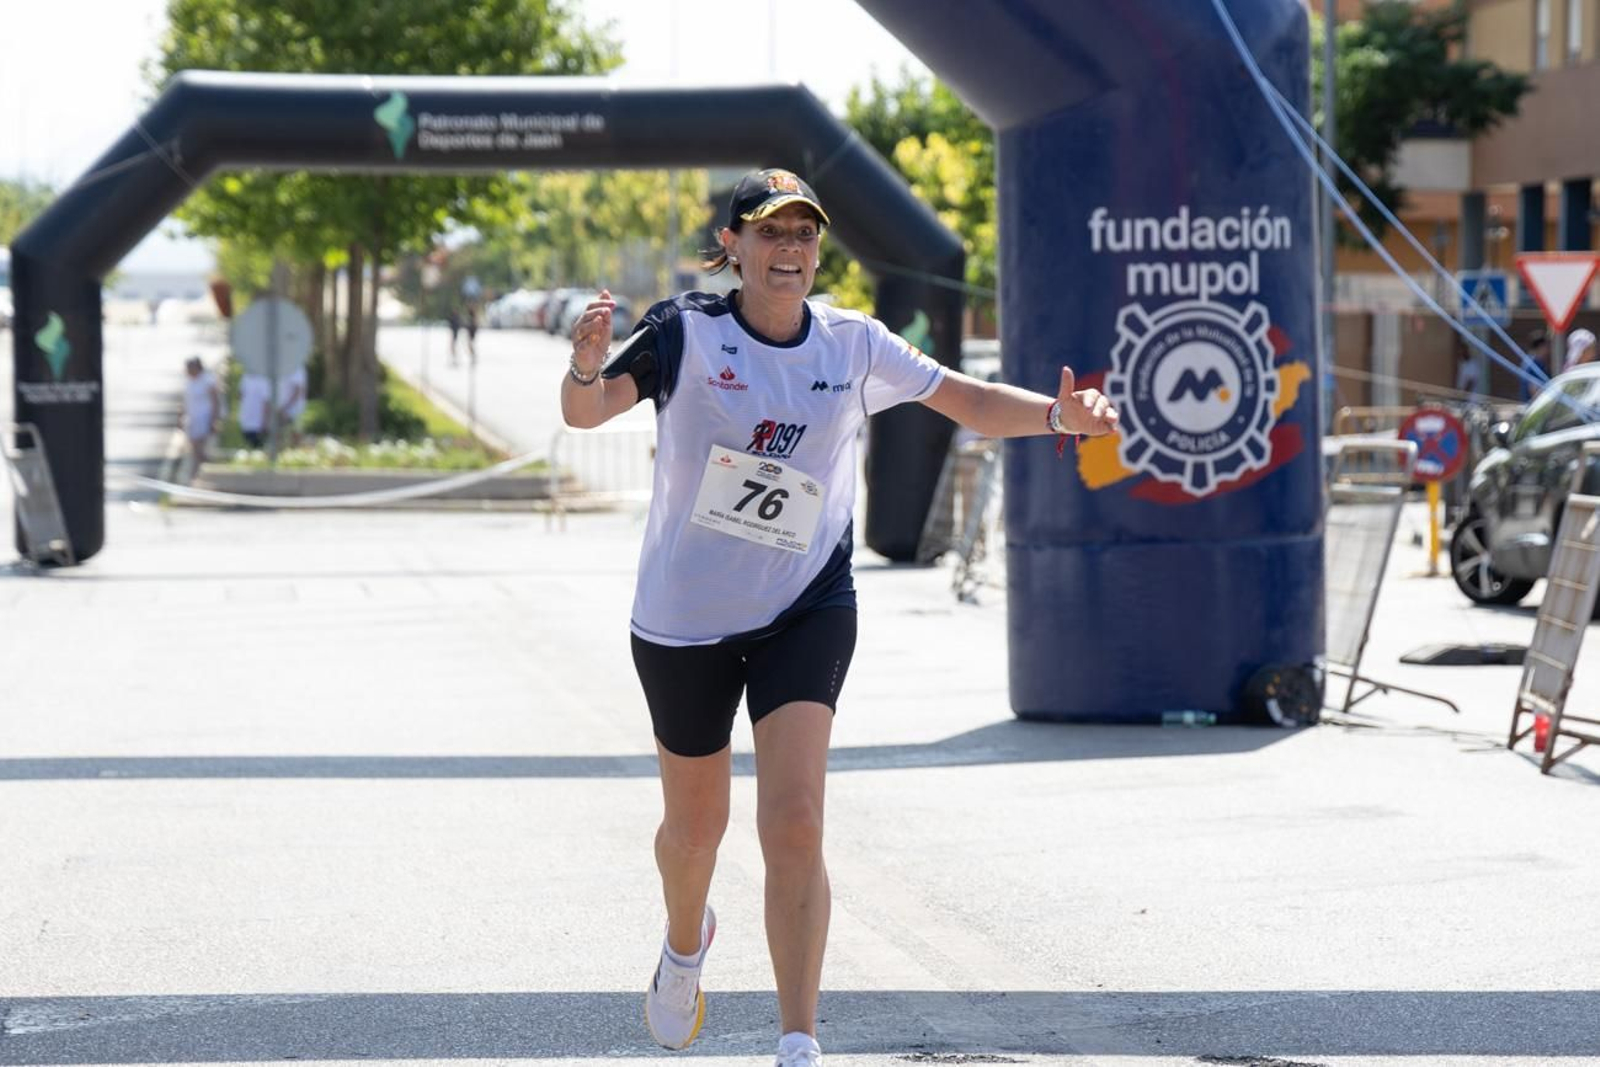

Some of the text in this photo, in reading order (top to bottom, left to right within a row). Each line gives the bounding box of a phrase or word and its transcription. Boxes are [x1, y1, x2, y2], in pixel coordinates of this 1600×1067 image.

[500, 112, 578, 133] Municipal
[1088, 205, 1291, 251] fundación
[1127, 250, 1259, 304] mupol
[733, 479, 790, 521] 76
